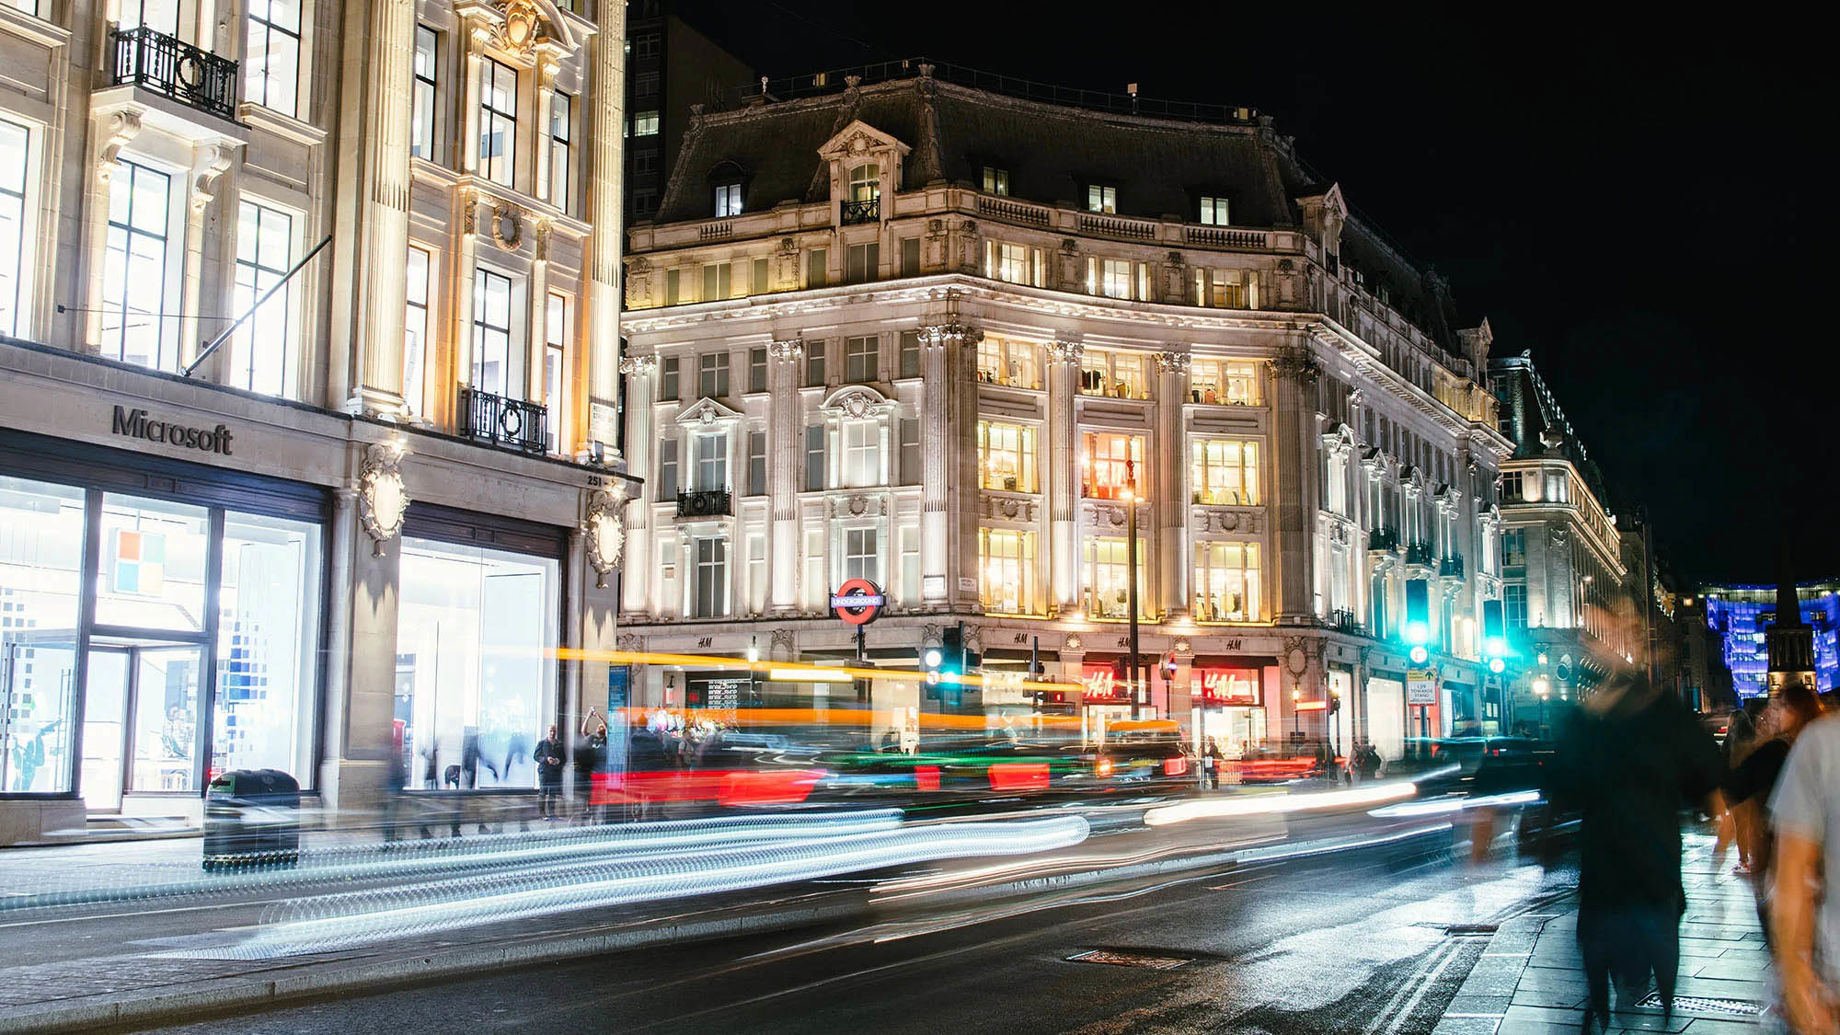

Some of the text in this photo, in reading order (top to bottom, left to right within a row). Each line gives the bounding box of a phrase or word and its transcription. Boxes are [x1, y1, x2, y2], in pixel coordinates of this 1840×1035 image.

[112, 405, 233, 455] Microsoft
[587, 475, 602, 487] 251
[832, 597, 880, 606] UNDERGROUND
